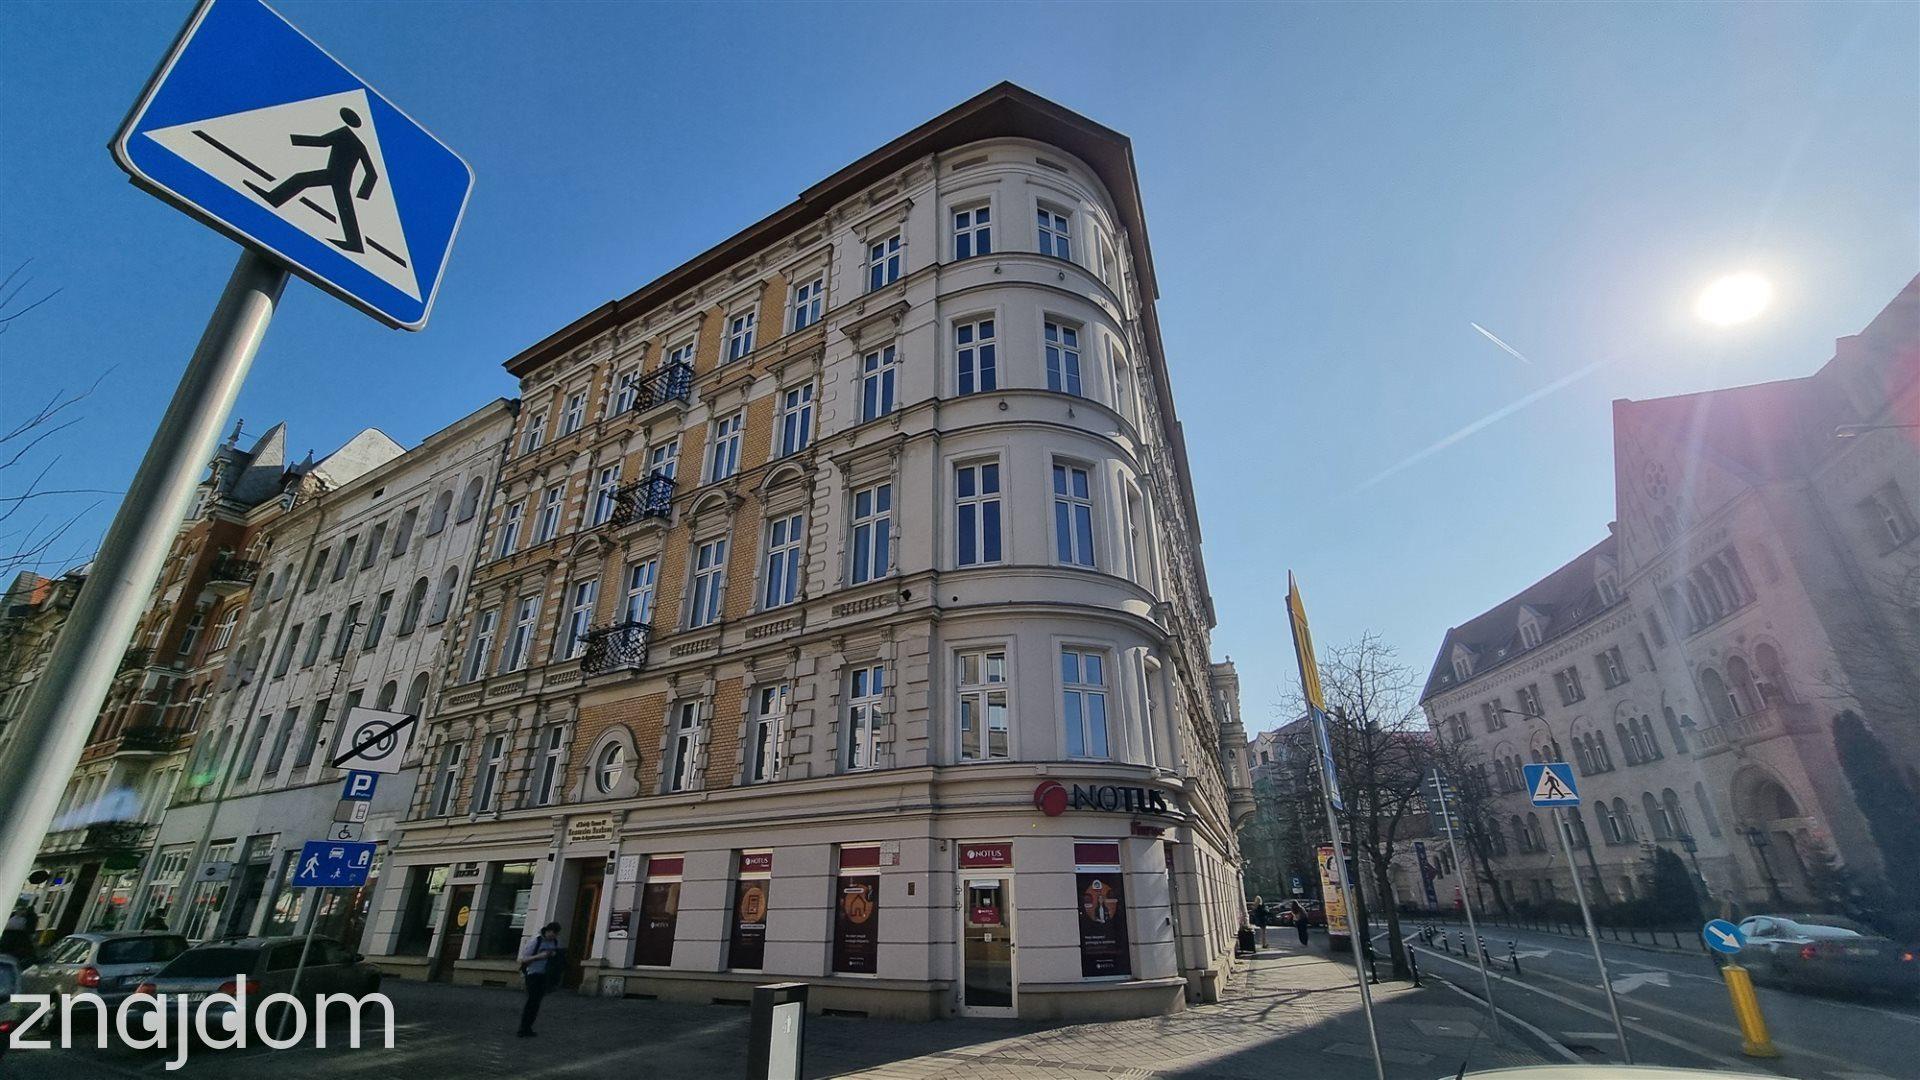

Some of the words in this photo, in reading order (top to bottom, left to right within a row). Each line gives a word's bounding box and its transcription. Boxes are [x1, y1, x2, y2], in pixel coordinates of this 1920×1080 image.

[350, 774, 372, 796] P
[1073, 784, 1167, 814] NOTUS
[975, 849, 1002, 857] NOTUS
